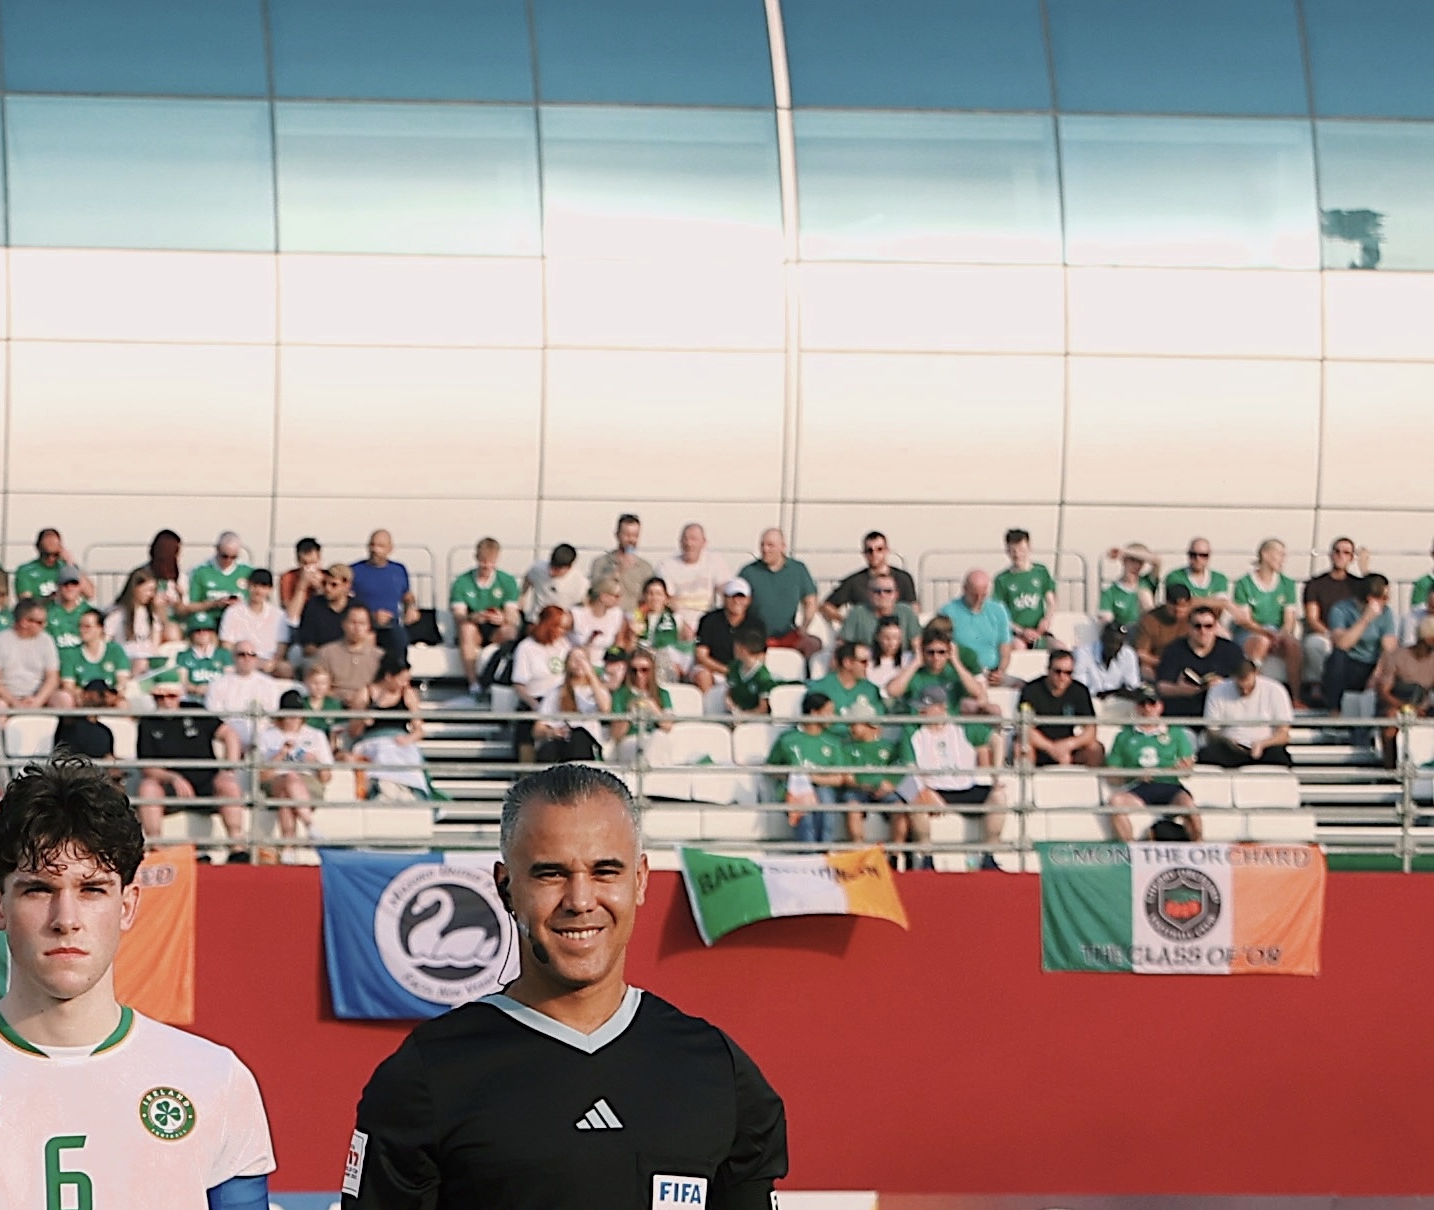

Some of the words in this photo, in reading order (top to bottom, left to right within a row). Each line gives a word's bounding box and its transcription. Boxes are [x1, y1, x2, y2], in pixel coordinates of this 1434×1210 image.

[1142, 847, 1184, 868] THE
[1188, 846, 1312, 869] ORCHARD
[1081, 944, 1125, 967] THE
[1130, 944, 1200, 967] CLASS
[1205, 946, 1237, 967] OF
[142, 1089, 190, 1107] IRELAND
[659, 1181, 701, 1204] FIFA
